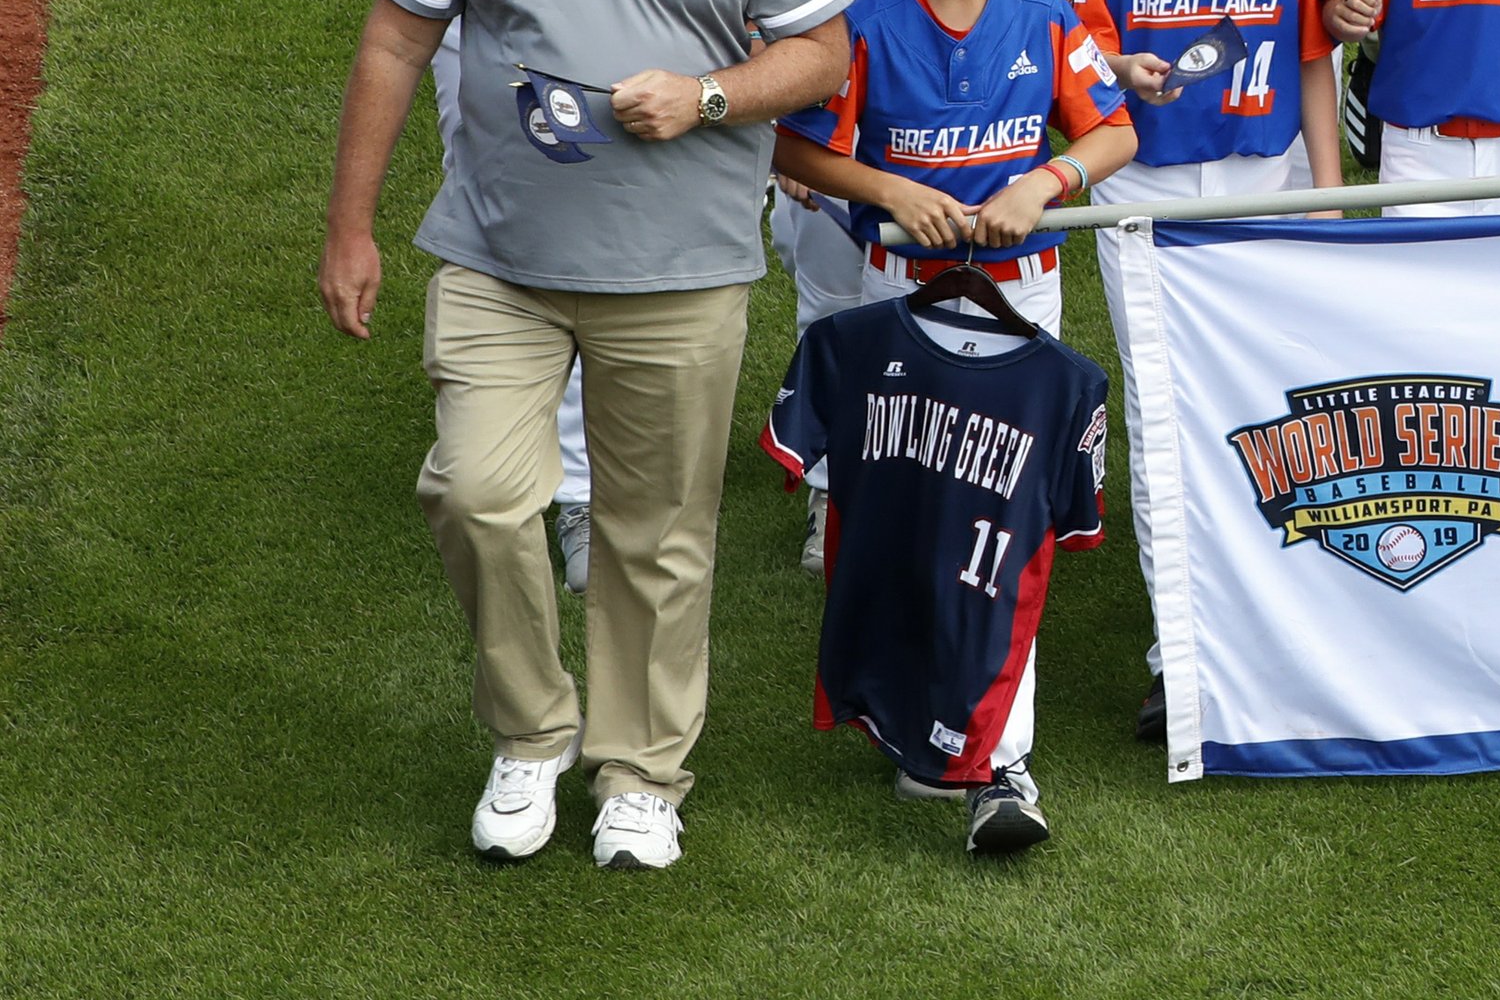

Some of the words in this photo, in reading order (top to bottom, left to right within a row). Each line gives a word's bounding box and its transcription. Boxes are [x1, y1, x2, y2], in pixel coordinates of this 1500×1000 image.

[1007, 64, 1038, 80] adas
[888, 126, 964, 157] GREAT
[969, 114, 1043, 153] LAKES
[1303, 387, 1377, 411] LITTLE
[1391, 385, 1475, 401] LEAGUE
[954, 412, 1034, 500] GREEN
[1231, 405, 1385, 503] WORLD
[1304, 474, 1490, 502] BASEBALL
[1468, 500, 1492, 517] PA
[1342, 533, 1370, 552] 20
[1433, 526, 1458, 546] 19
[959, 518, 1011, 599] 11
